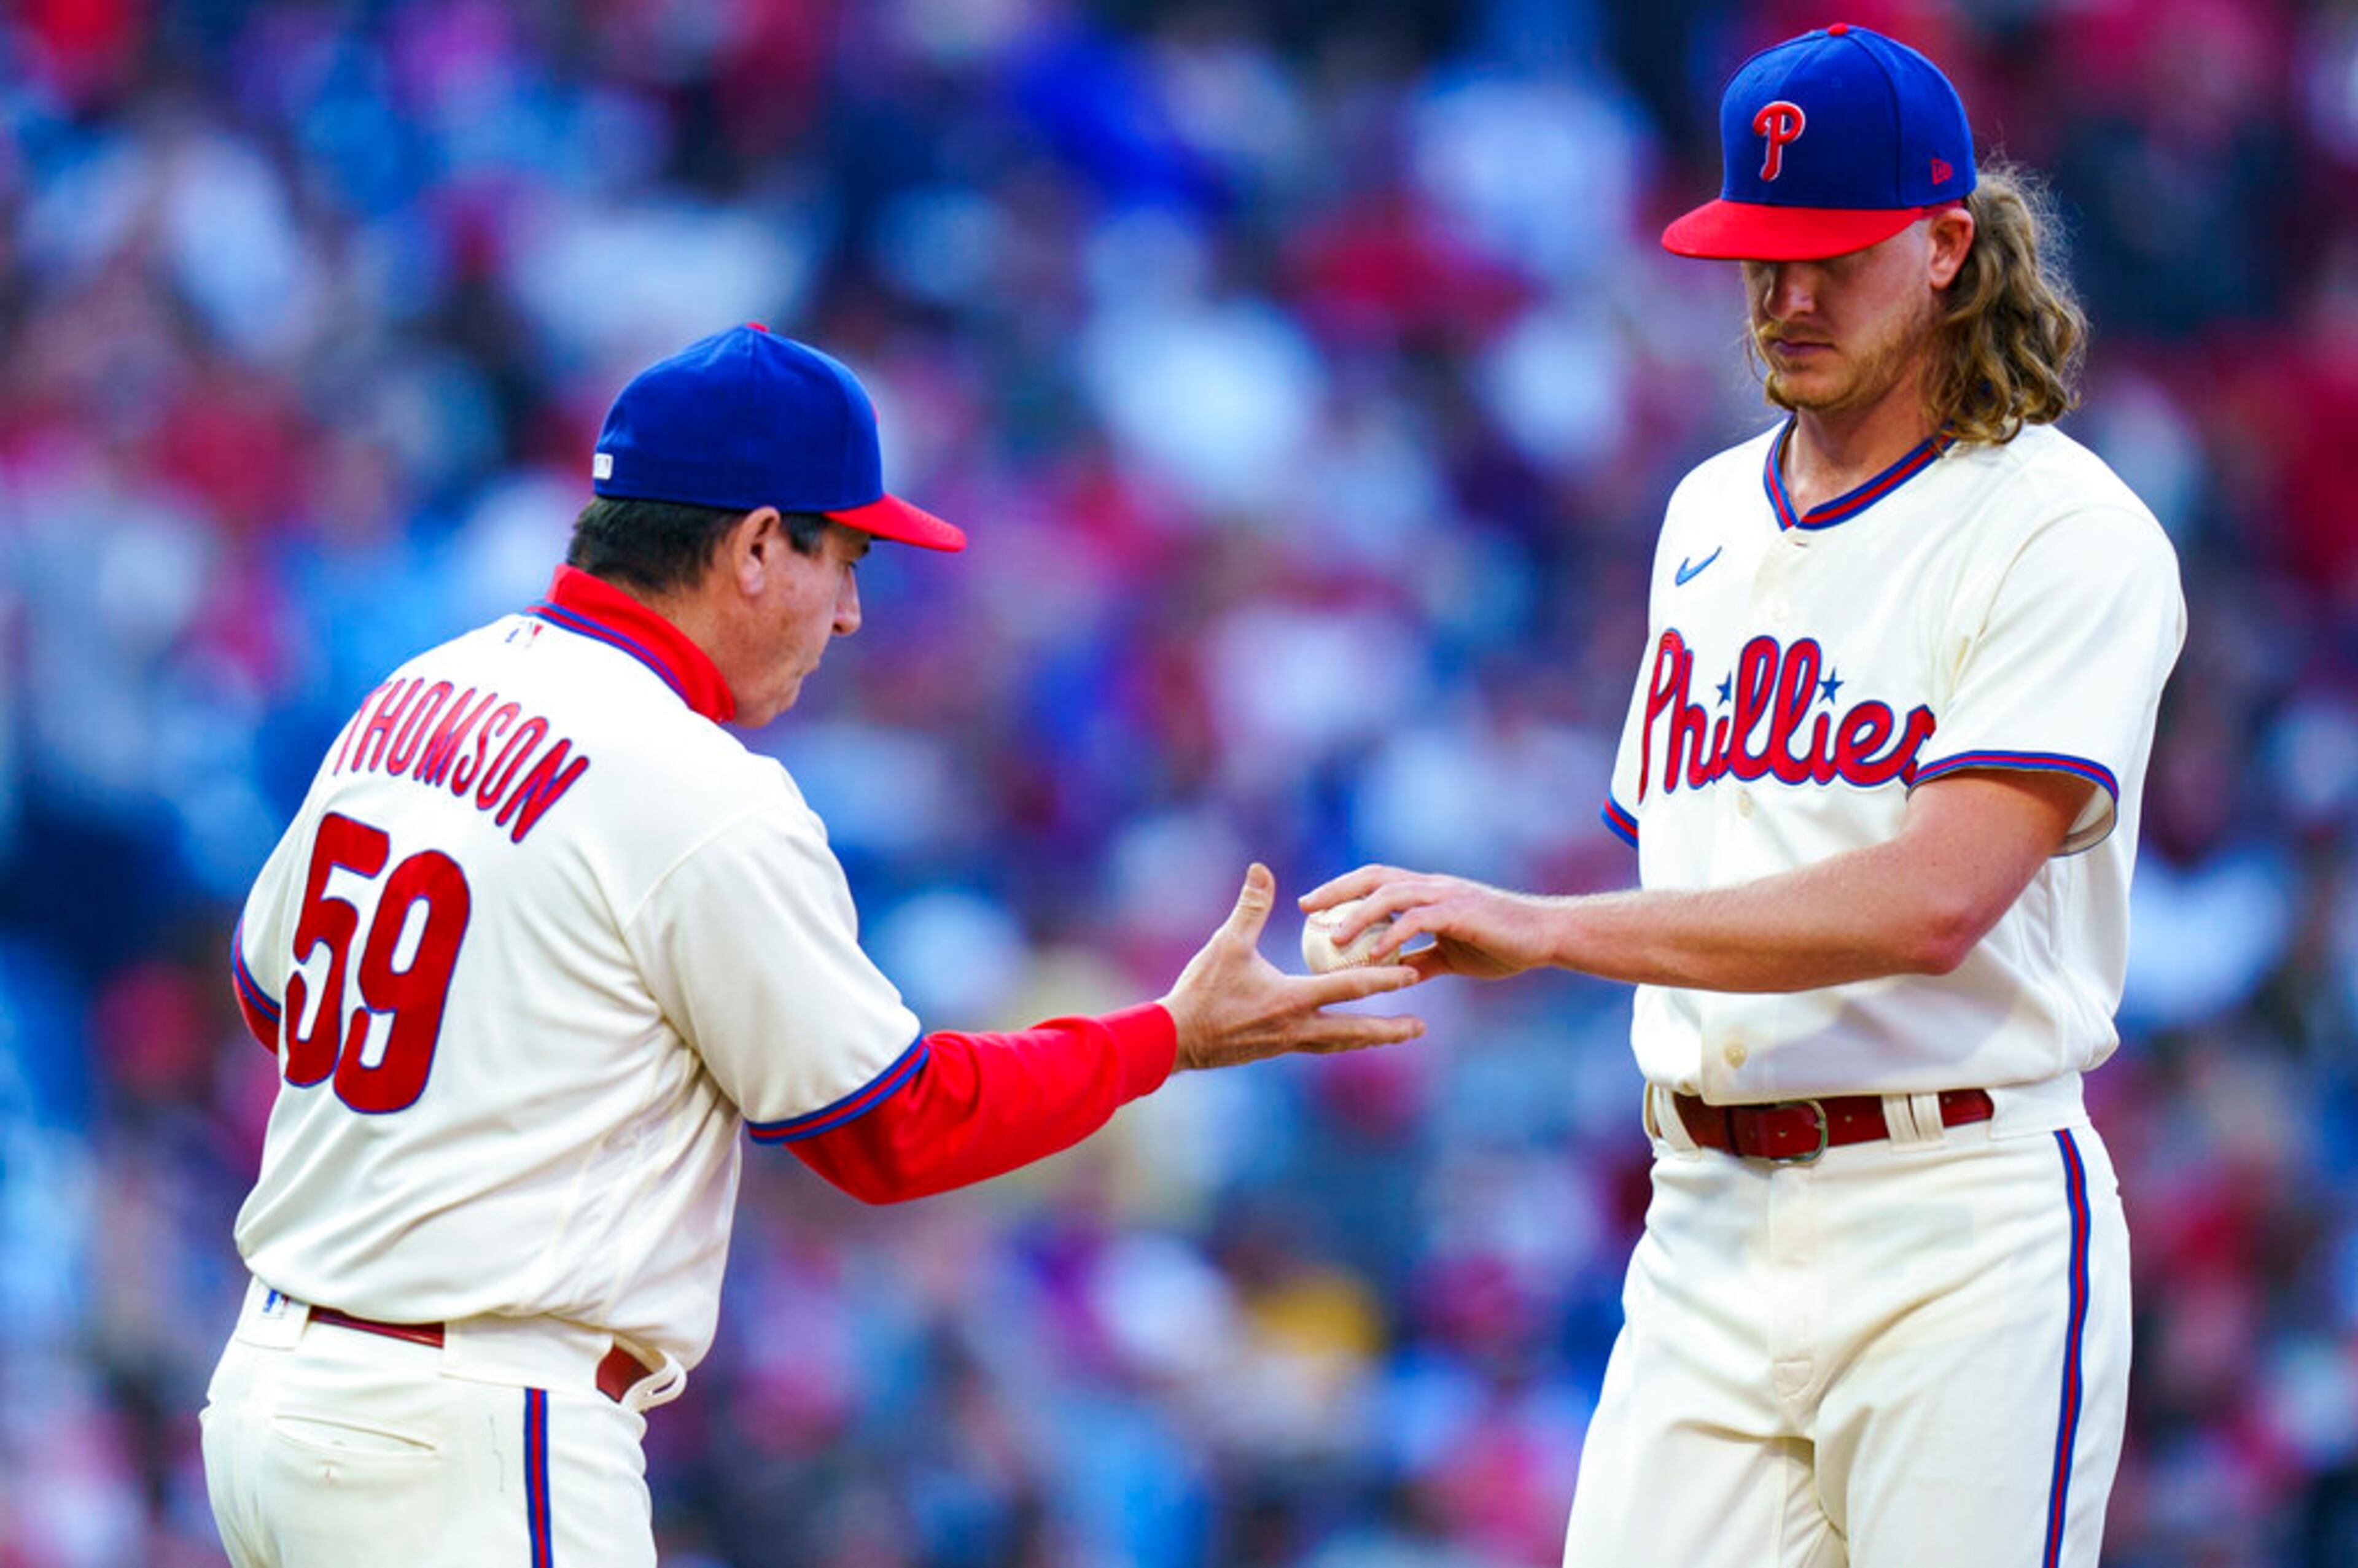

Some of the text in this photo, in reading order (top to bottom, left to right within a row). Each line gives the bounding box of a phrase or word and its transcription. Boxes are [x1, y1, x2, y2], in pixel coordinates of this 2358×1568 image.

[1753, 101, 1806, 181] P
[333, 677, 590, 844] THOMSON
[284, 812, 471, 1114] 59
